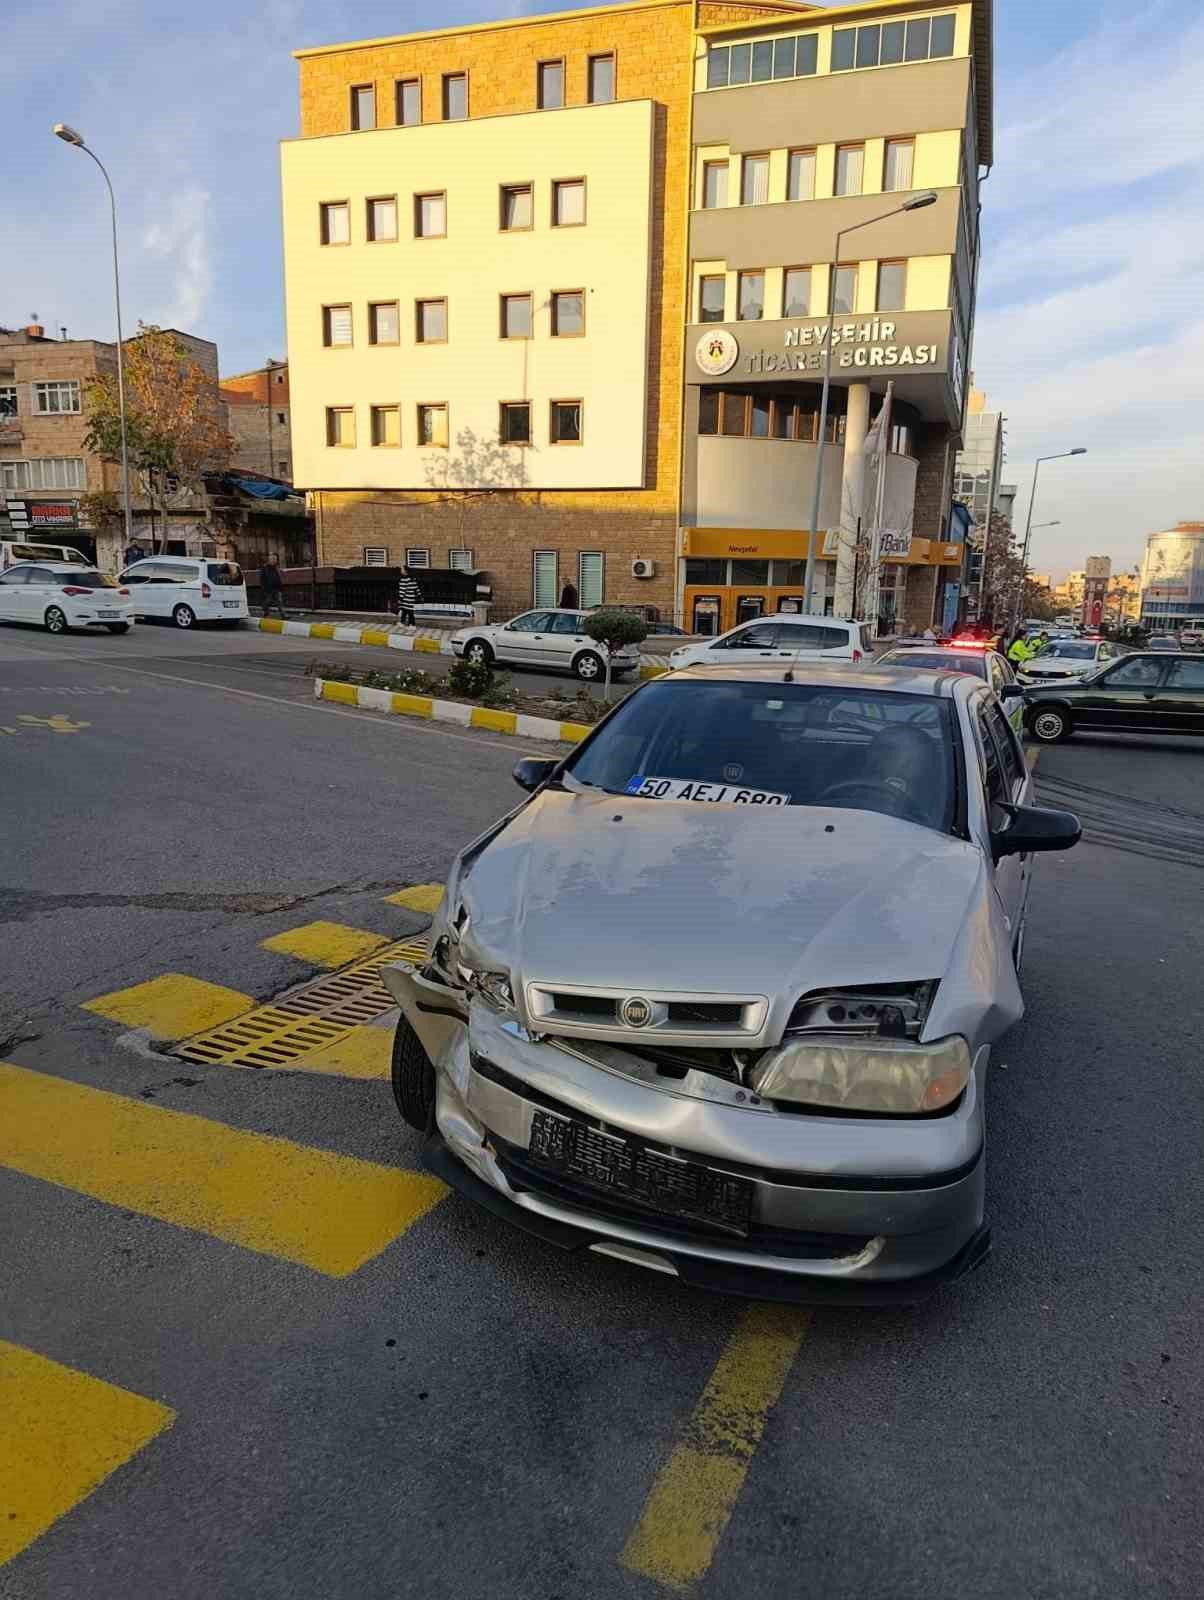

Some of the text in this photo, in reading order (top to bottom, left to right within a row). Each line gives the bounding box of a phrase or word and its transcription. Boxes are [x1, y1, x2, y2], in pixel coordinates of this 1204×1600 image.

[784, 317, 896, 348] NEVŞEHİR
[839, 344, 937, 368] BORSASI
[640, 780, 671, 797] 50
[677, 784, 727, 803] AEJ
[628, 1007, 645, 1017] FIAT
